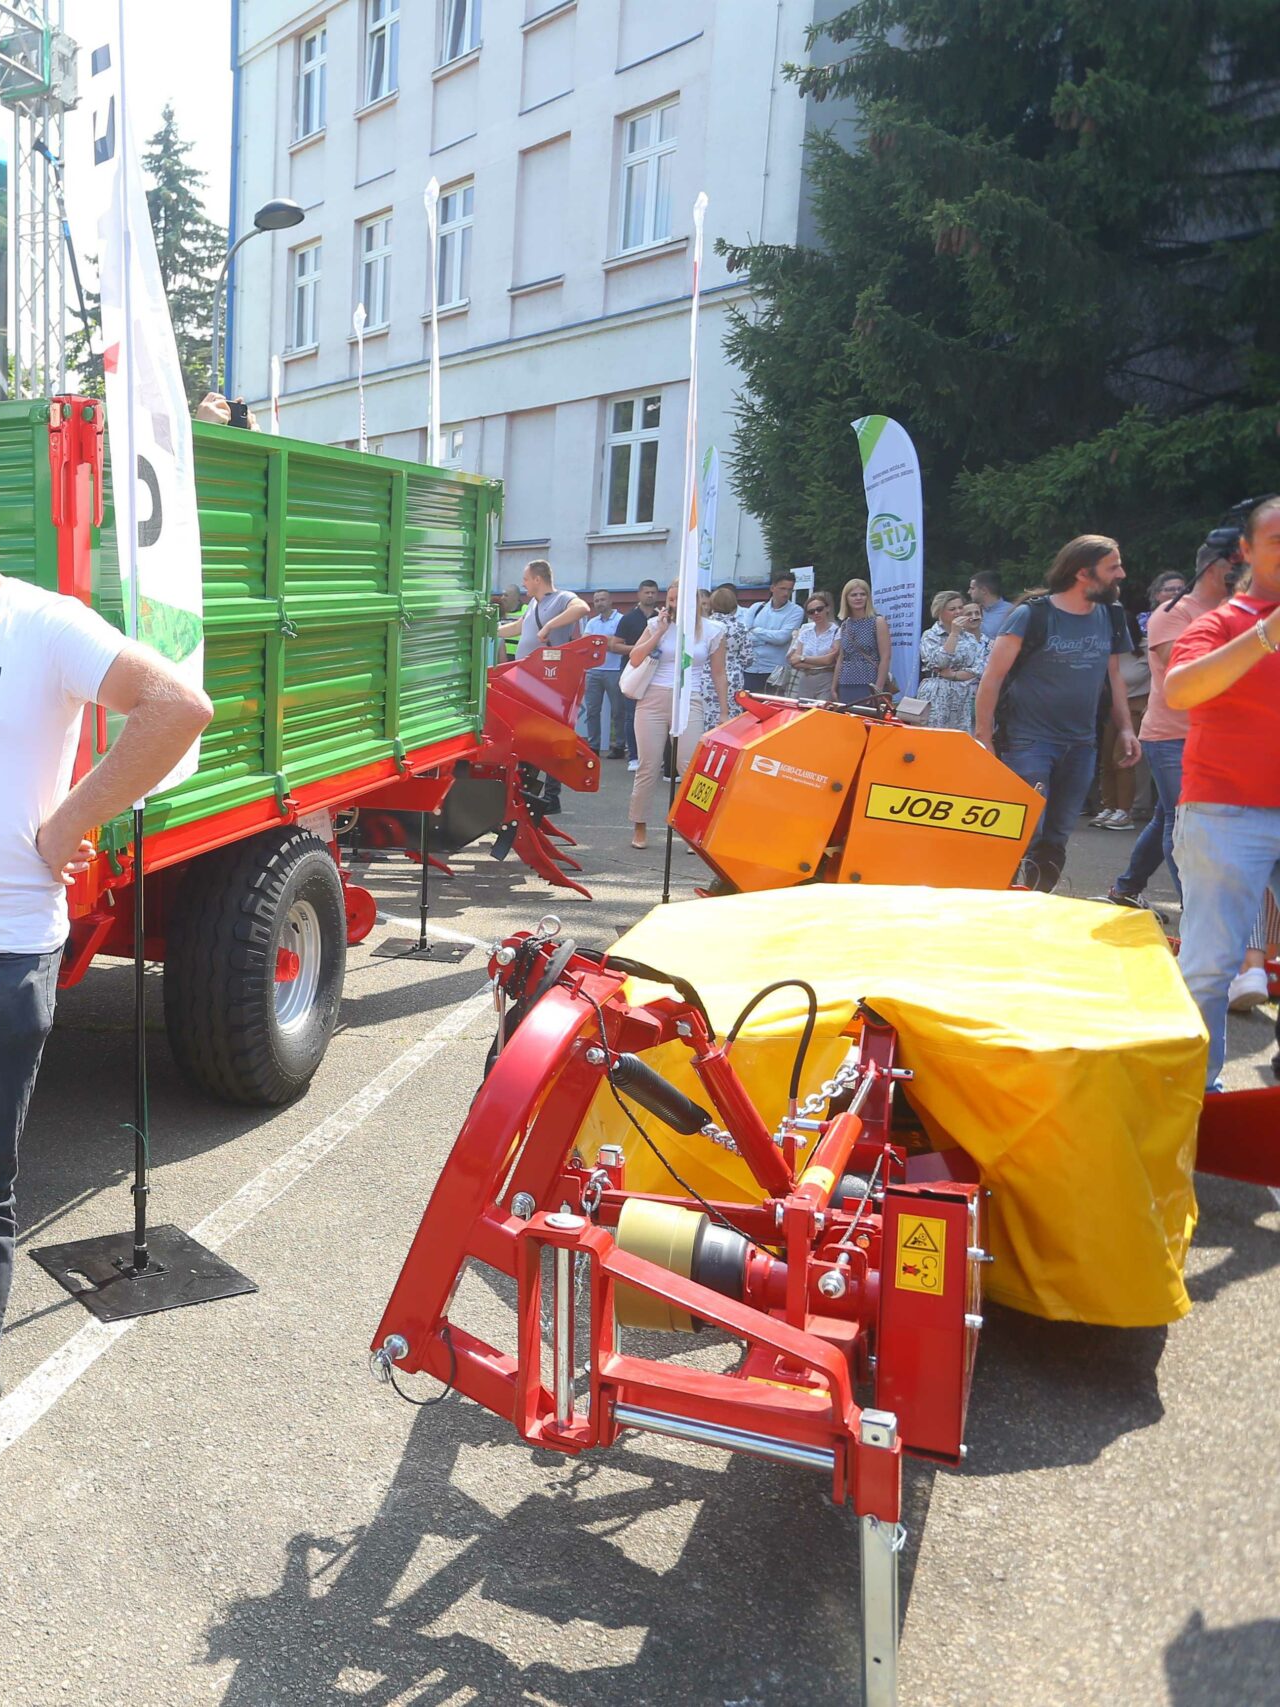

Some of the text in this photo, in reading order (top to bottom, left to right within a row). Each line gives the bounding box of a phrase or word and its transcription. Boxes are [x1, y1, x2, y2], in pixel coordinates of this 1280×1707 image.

[1043, 634, 1083, 654] Road
[690, 780, 713, 804] JOB 50
[889, 795, 1001, 828] JOB 50
